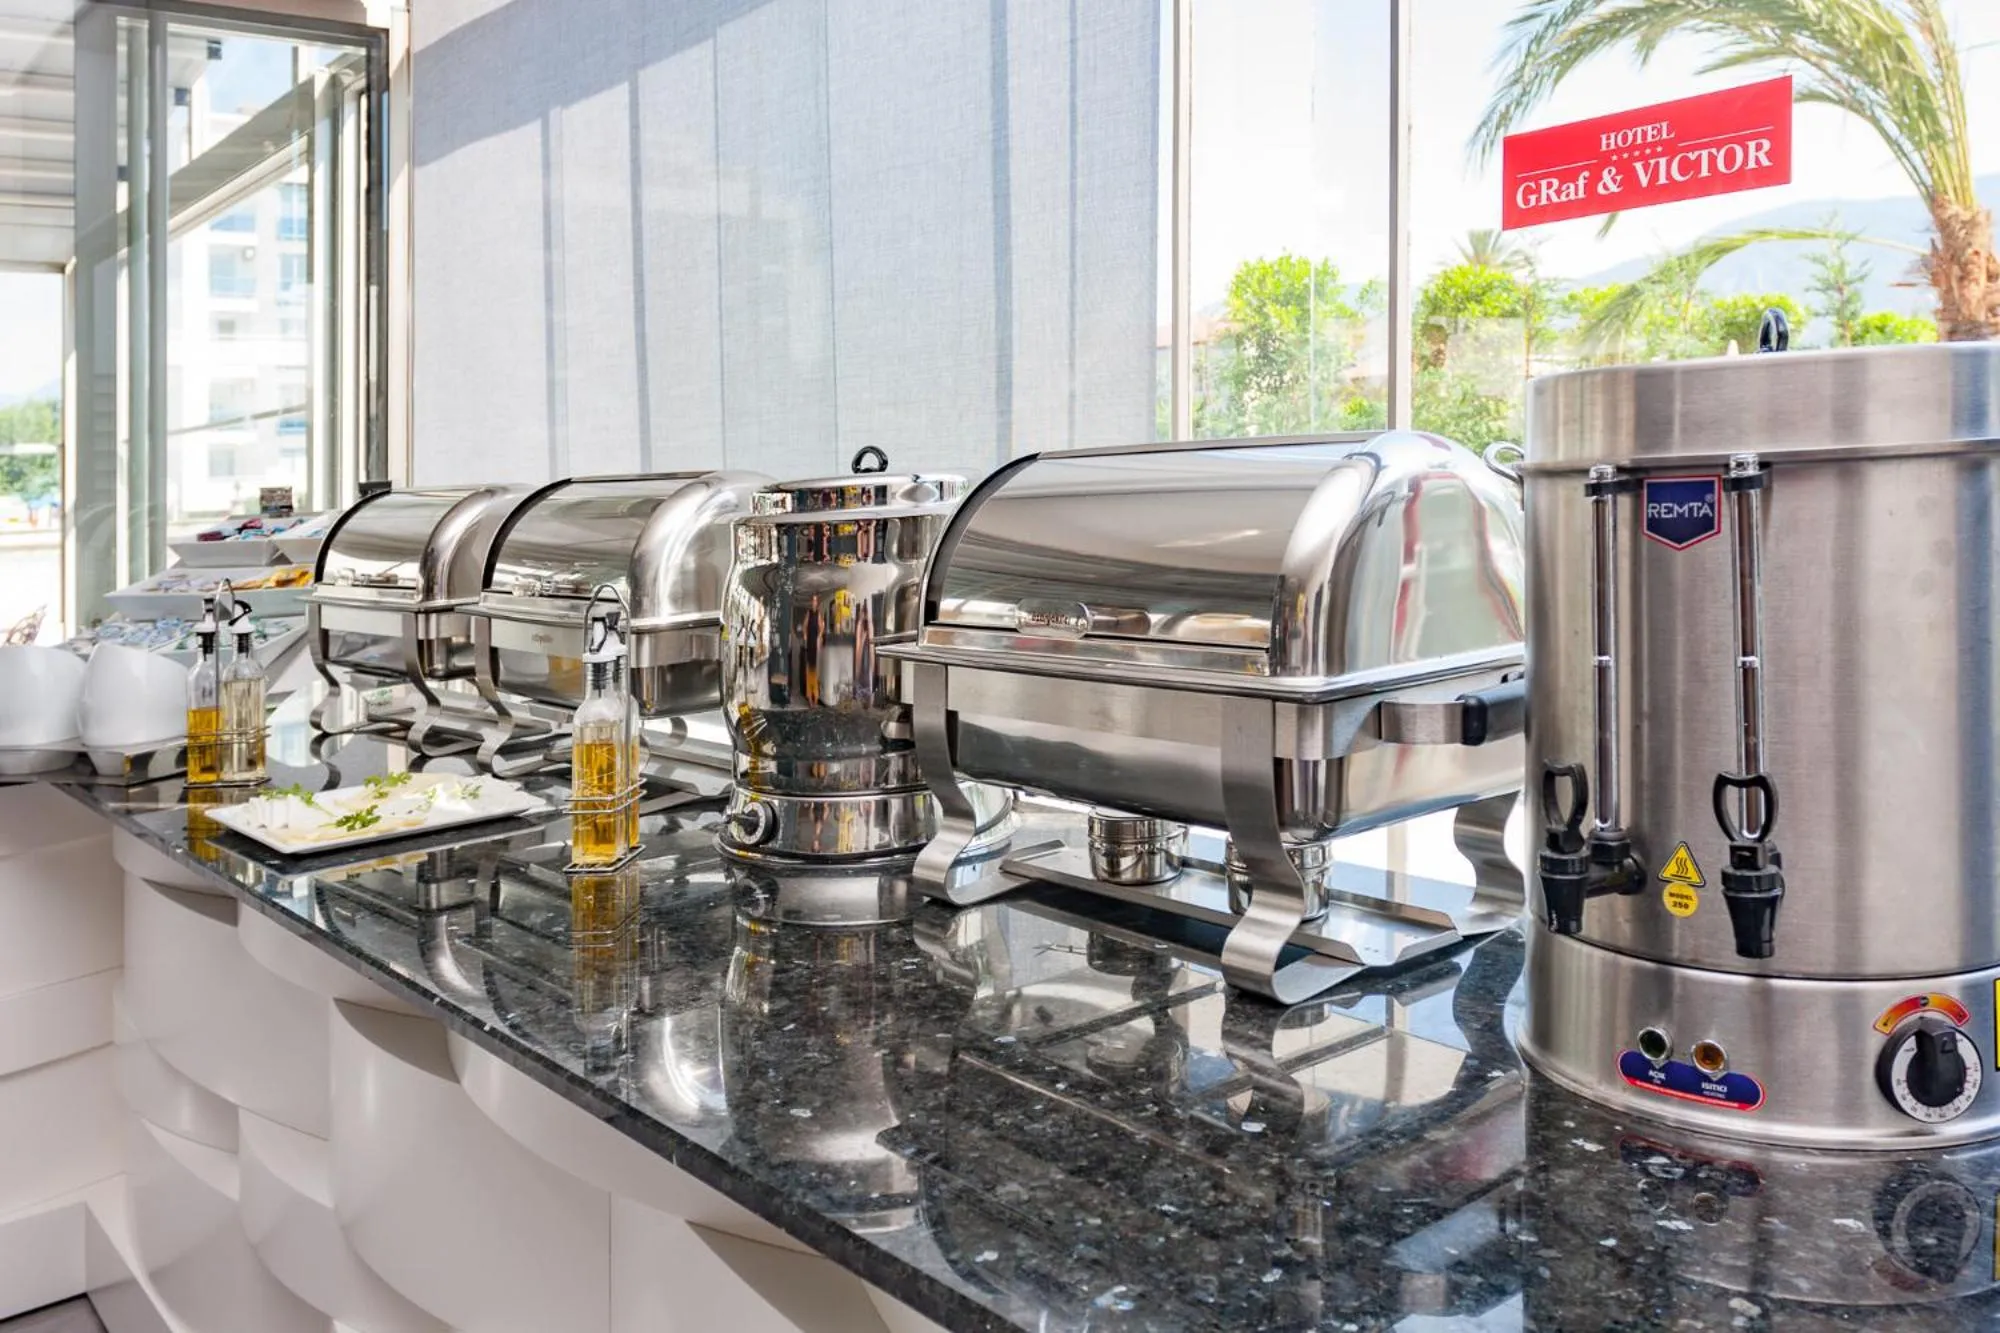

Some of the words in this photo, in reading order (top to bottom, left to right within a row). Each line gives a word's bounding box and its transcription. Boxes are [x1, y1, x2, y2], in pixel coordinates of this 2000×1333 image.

[1600, 121, 1675, 152] HOTEL
[1516, 170, 1590, 209] GRaf
[1597, 166, 1624, 195] &
[1632, 137, 1774, 188] VICTOR
[1647, 502, 1713, 518] REMTA
